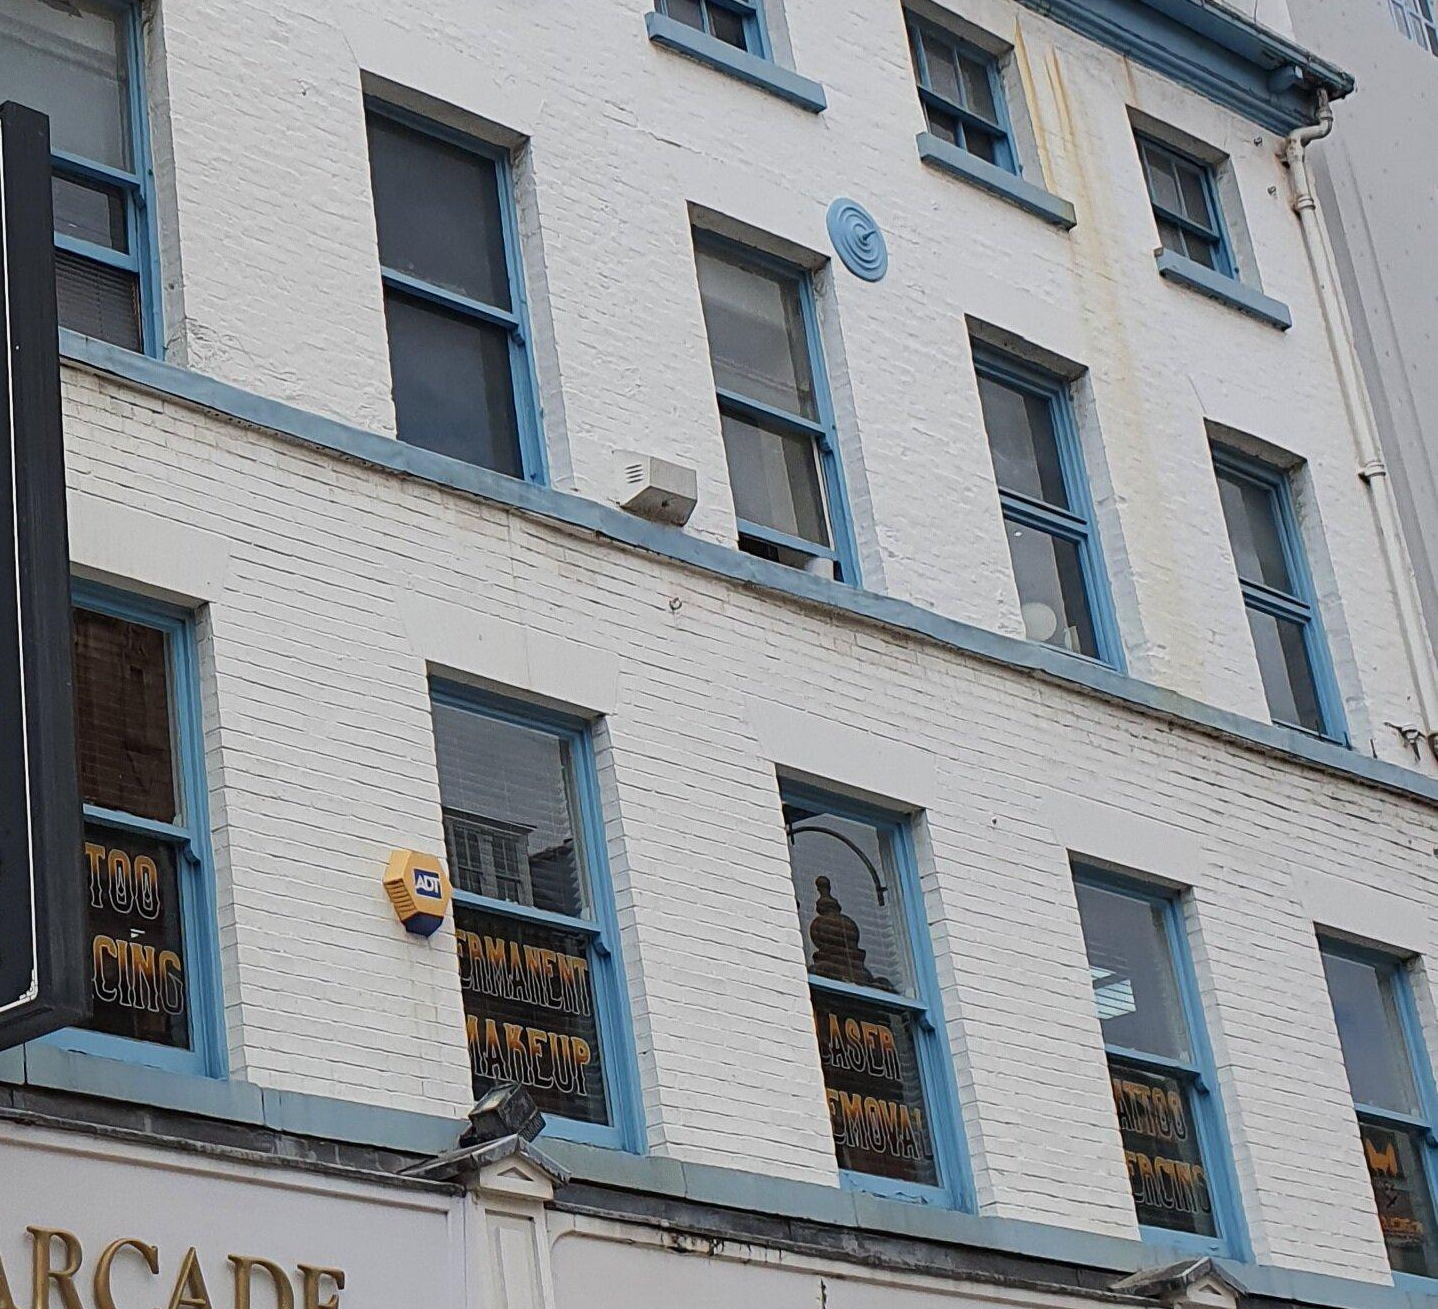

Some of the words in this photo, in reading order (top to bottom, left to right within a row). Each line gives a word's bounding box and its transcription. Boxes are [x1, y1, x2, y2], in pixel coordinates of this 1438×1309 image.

[415, 873, 441, 894] ADT
[91, 933, 185, 1016] CING
[818, 1012, 903, 1082] ASER
